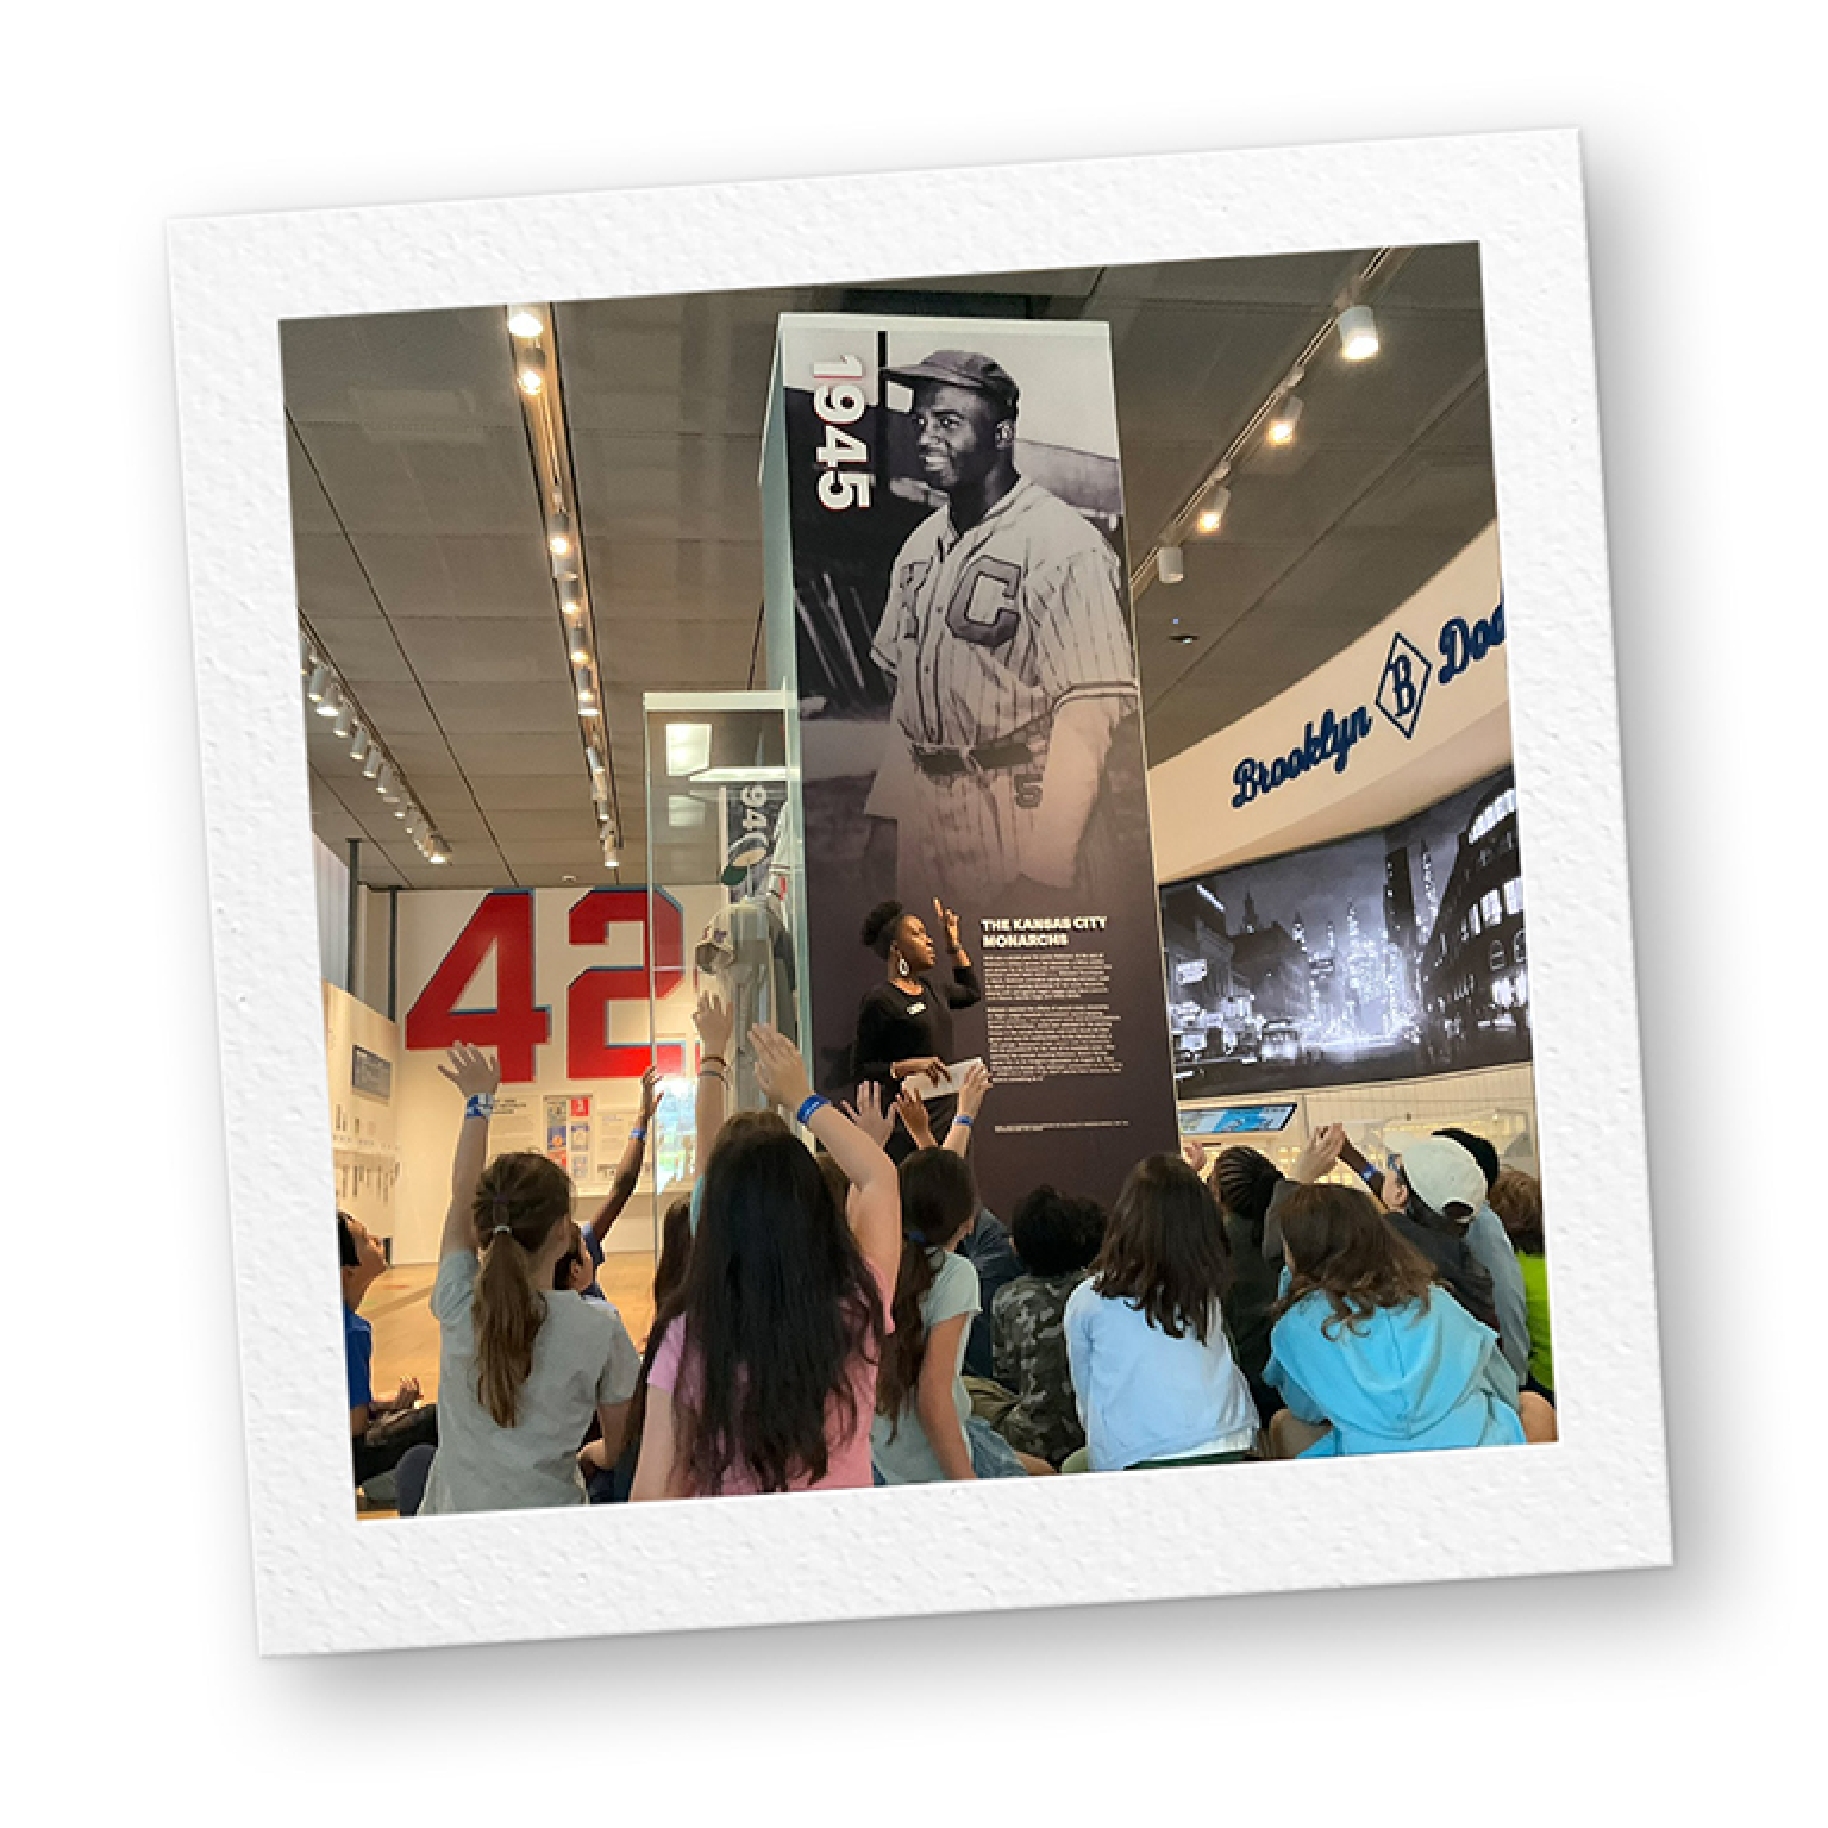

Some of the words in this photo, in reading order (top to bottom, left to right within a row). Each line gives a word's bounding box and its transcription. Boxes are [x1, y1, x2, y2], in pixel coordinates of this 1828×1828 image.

[812, 354, 871, 510] 1945
[945, 554, 1022, 648] C
[1231, 706, 1373, 808] Brooklyn
[1386, 653, 1417, 718] B
[404, 887, 686, 1083] 42
[981, 918, 1010, 932] THE
[1013, 917, 1071, 931] KANSAS
[1072, 915, 1108, 930] CITY
[982, 934, 1069, 948] MONARCHS
